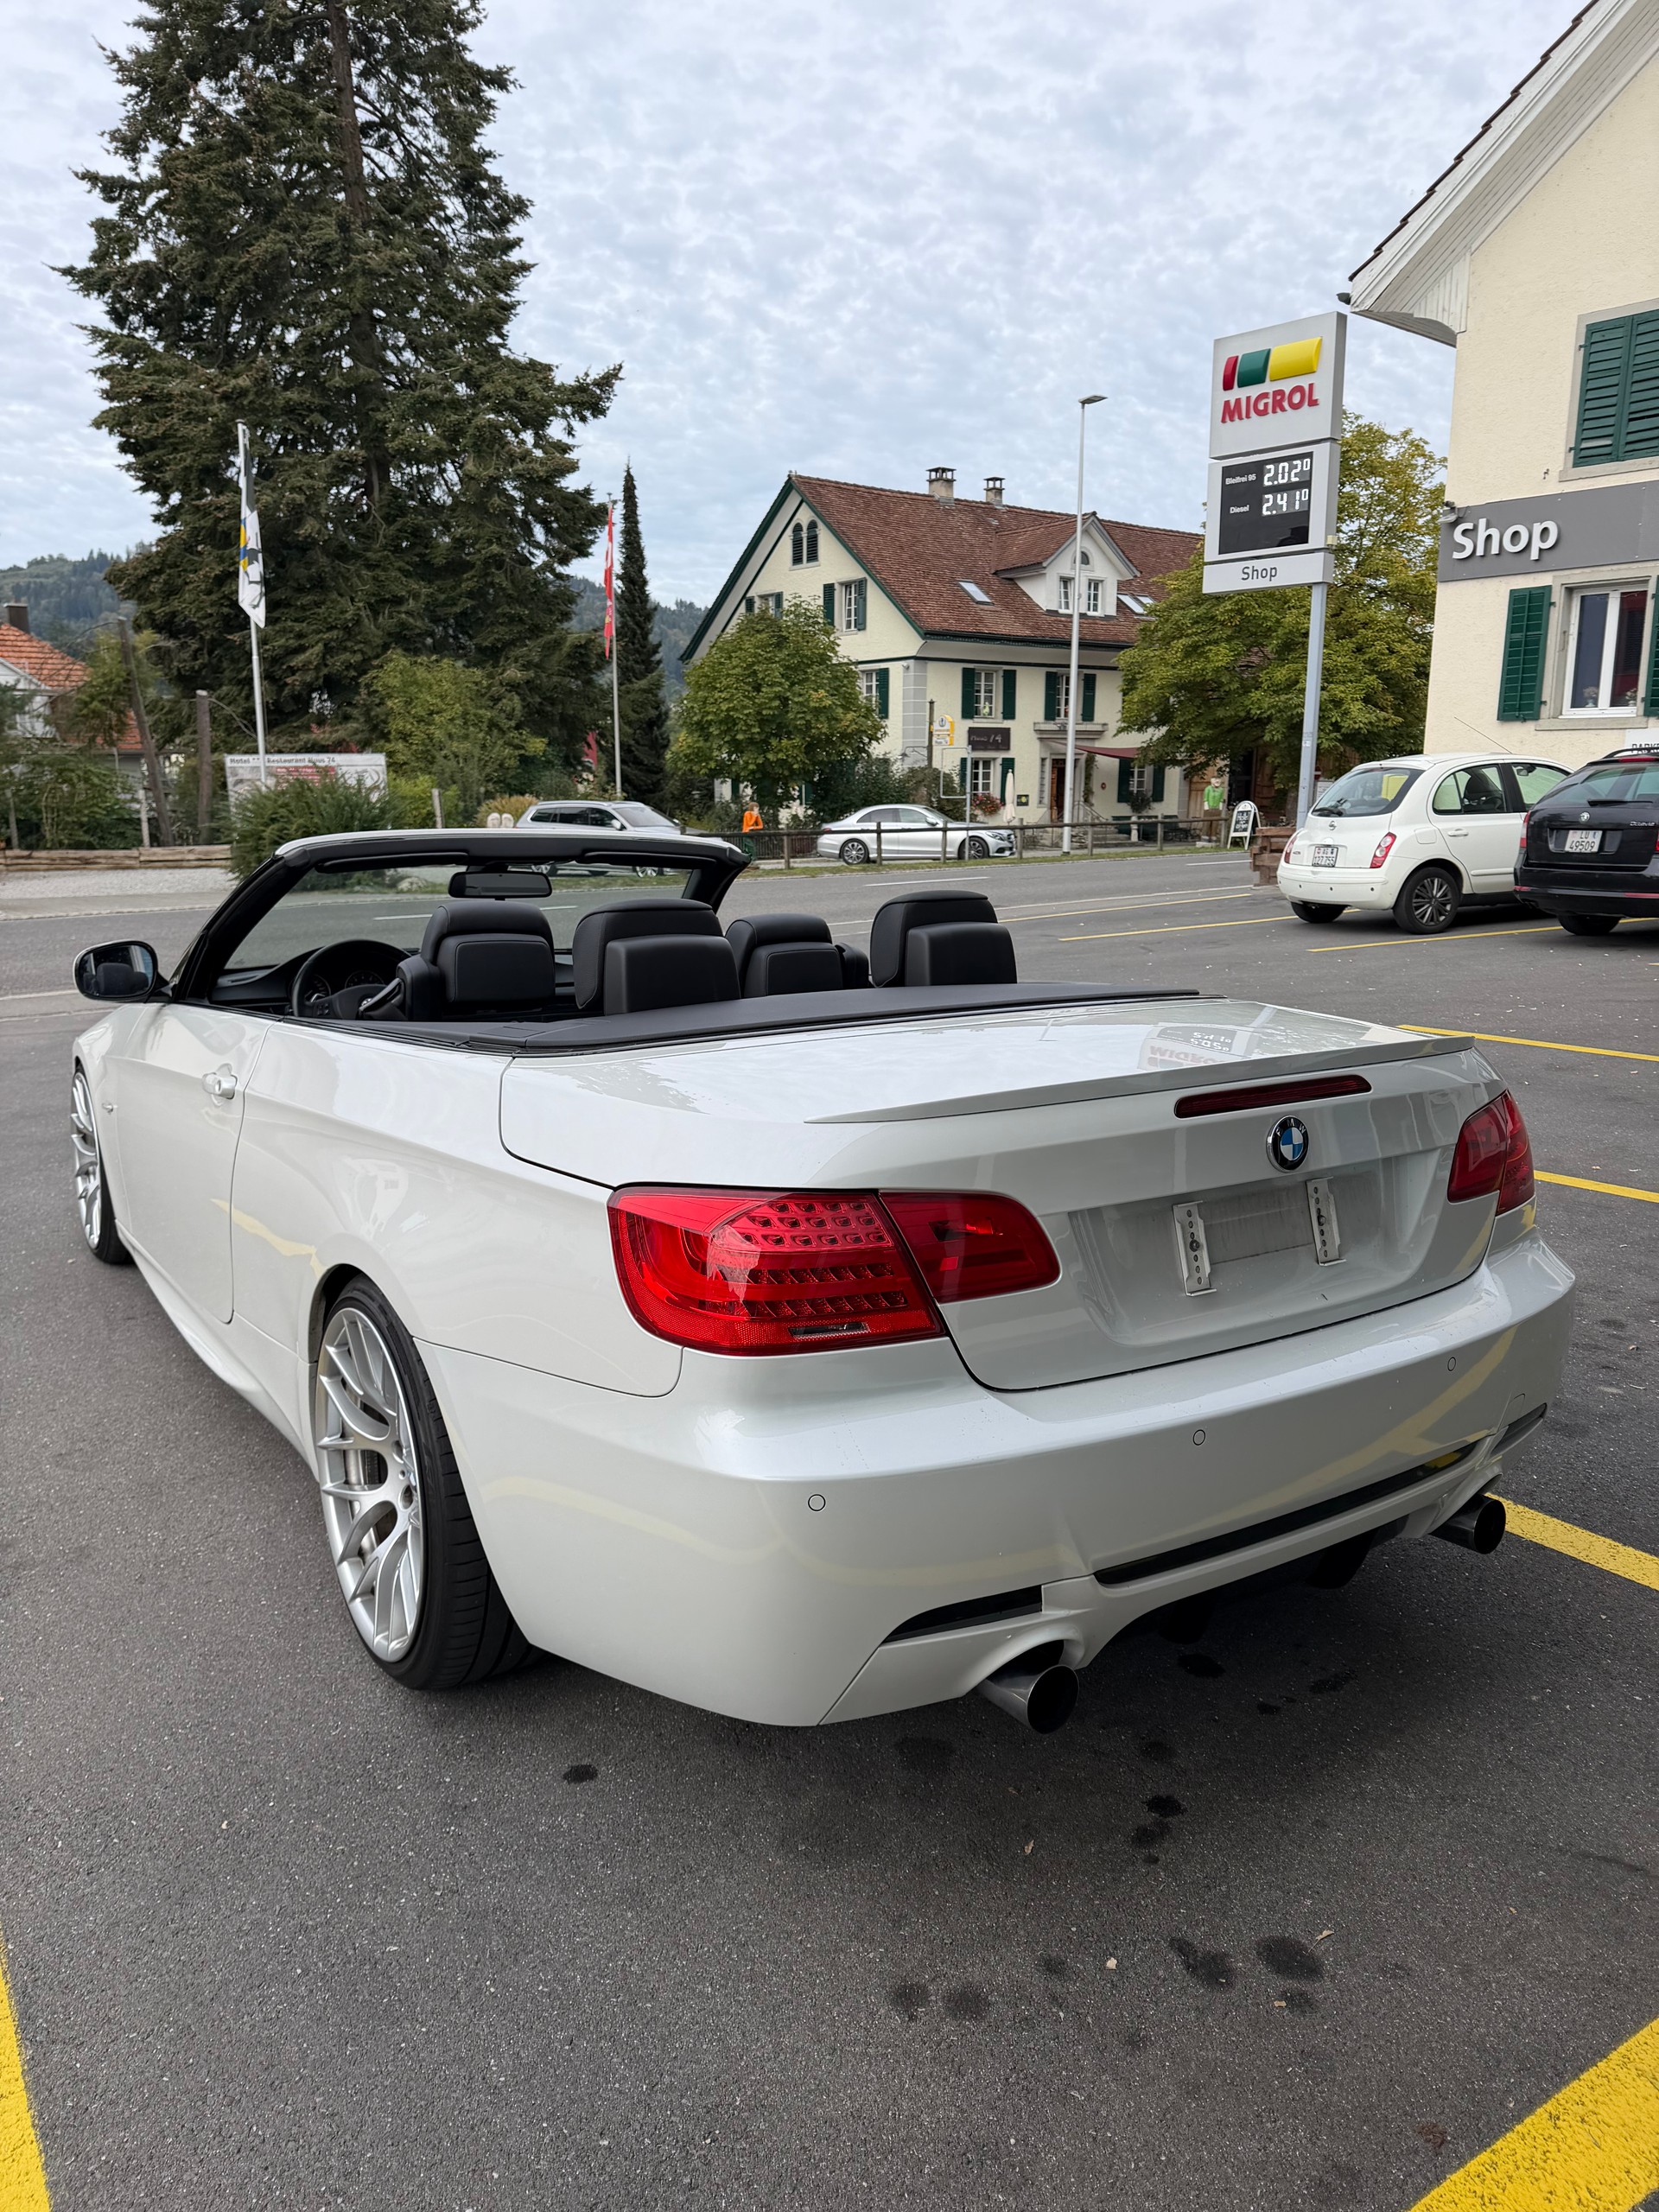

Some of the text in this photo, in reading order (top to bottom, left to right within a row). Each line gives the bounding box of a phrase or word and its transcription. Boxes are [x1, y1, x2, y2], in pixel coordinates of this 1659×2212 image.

[1221, 383, 1319, 423] MIGROL
[1225, 474, 1248, 485] Bleifrei
[1230, 505, 1249, 513] Diesel
[1452, 518, 1559, 561] Shop
[1241, 566, 1278, 582] Shop
[1569, 840, 1596, 852] 49509
[1275, 1118, 1306, 1137] BMW
